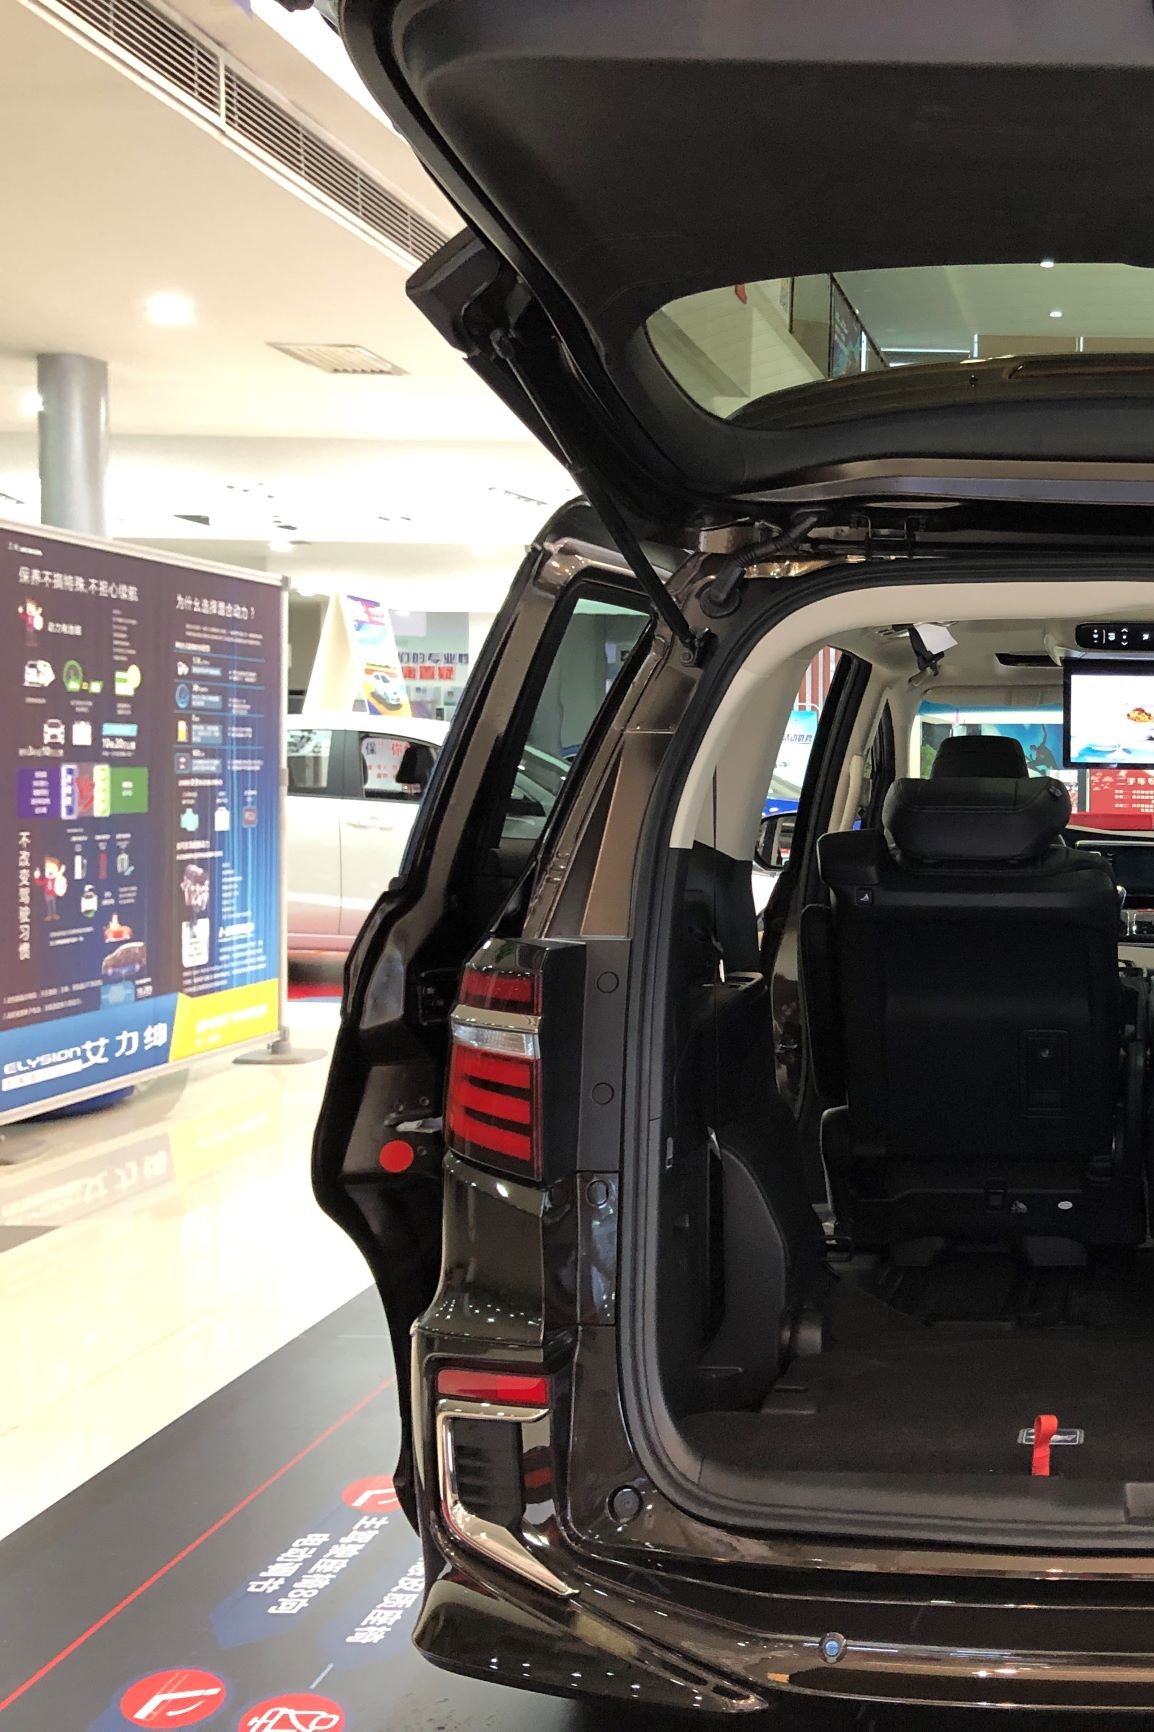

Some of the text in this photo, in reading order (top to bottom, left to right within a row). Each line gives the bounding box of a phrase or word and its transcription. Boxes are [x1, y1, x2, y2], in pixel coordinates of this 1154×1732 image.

[246, 1532, 331, 1594] 电动调节
[267, 1515, 390, 1614] 主驾驶座椅8向
